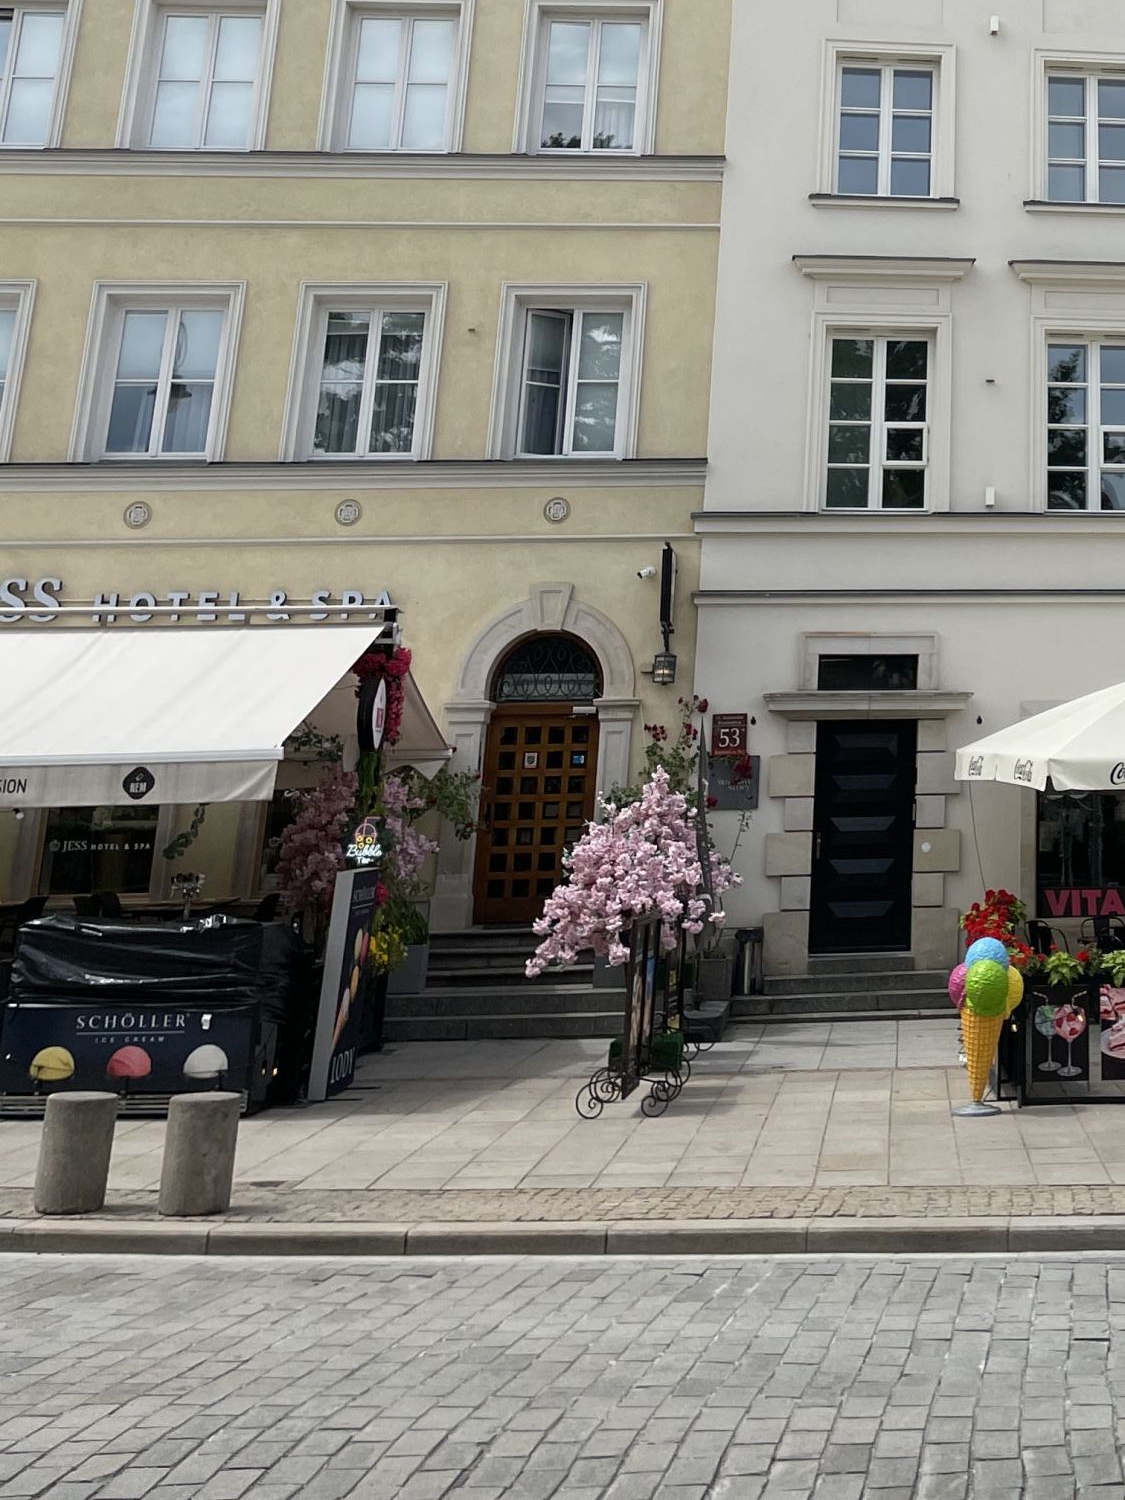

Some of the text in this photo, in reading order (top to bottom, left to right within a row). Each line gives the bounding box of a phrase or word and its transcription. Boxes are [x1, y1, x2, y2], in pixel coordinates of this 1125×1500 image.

[92, 592, 246, 621] HOTEL
[266, 590, 290, 620] &
[310, 590, 392, 620] SPA
[718, 727, 740, 748] 53
[0, 778, 28, 794] ION
[62, 840, 88, 852] JESS
[134, 842, 150, 850] SPA
[76, 1012, 186, 1029] SCHÖLLER
